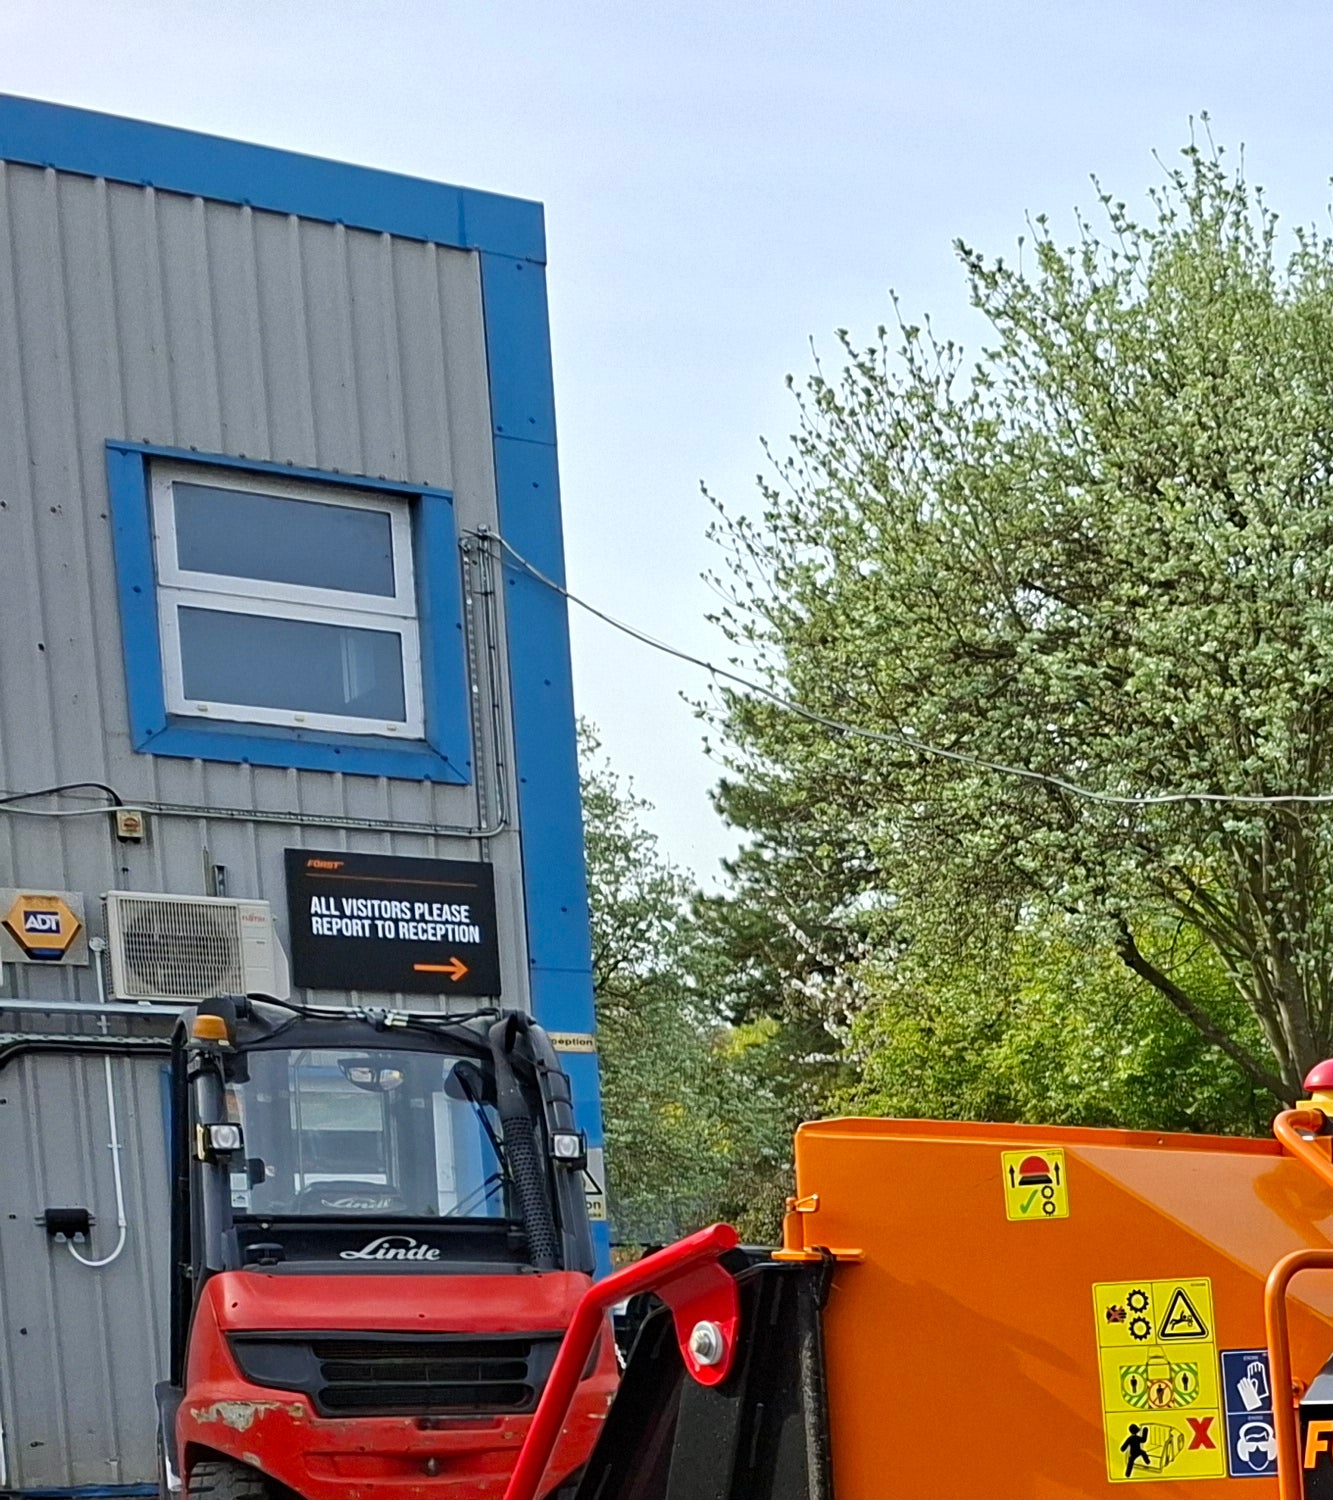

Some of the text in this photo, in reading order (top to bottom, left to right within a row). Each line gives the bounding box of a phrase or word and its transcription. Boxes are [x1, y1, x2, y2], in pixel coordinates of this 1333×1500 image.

[311, 896, 470, 923] ALL VISITORS PLEASE
[25, 915, 60, 931] ADT
[312, 916, 480, 943] REPORT TO RECEPTION
[339, 1235, 440, 1261] Linde
